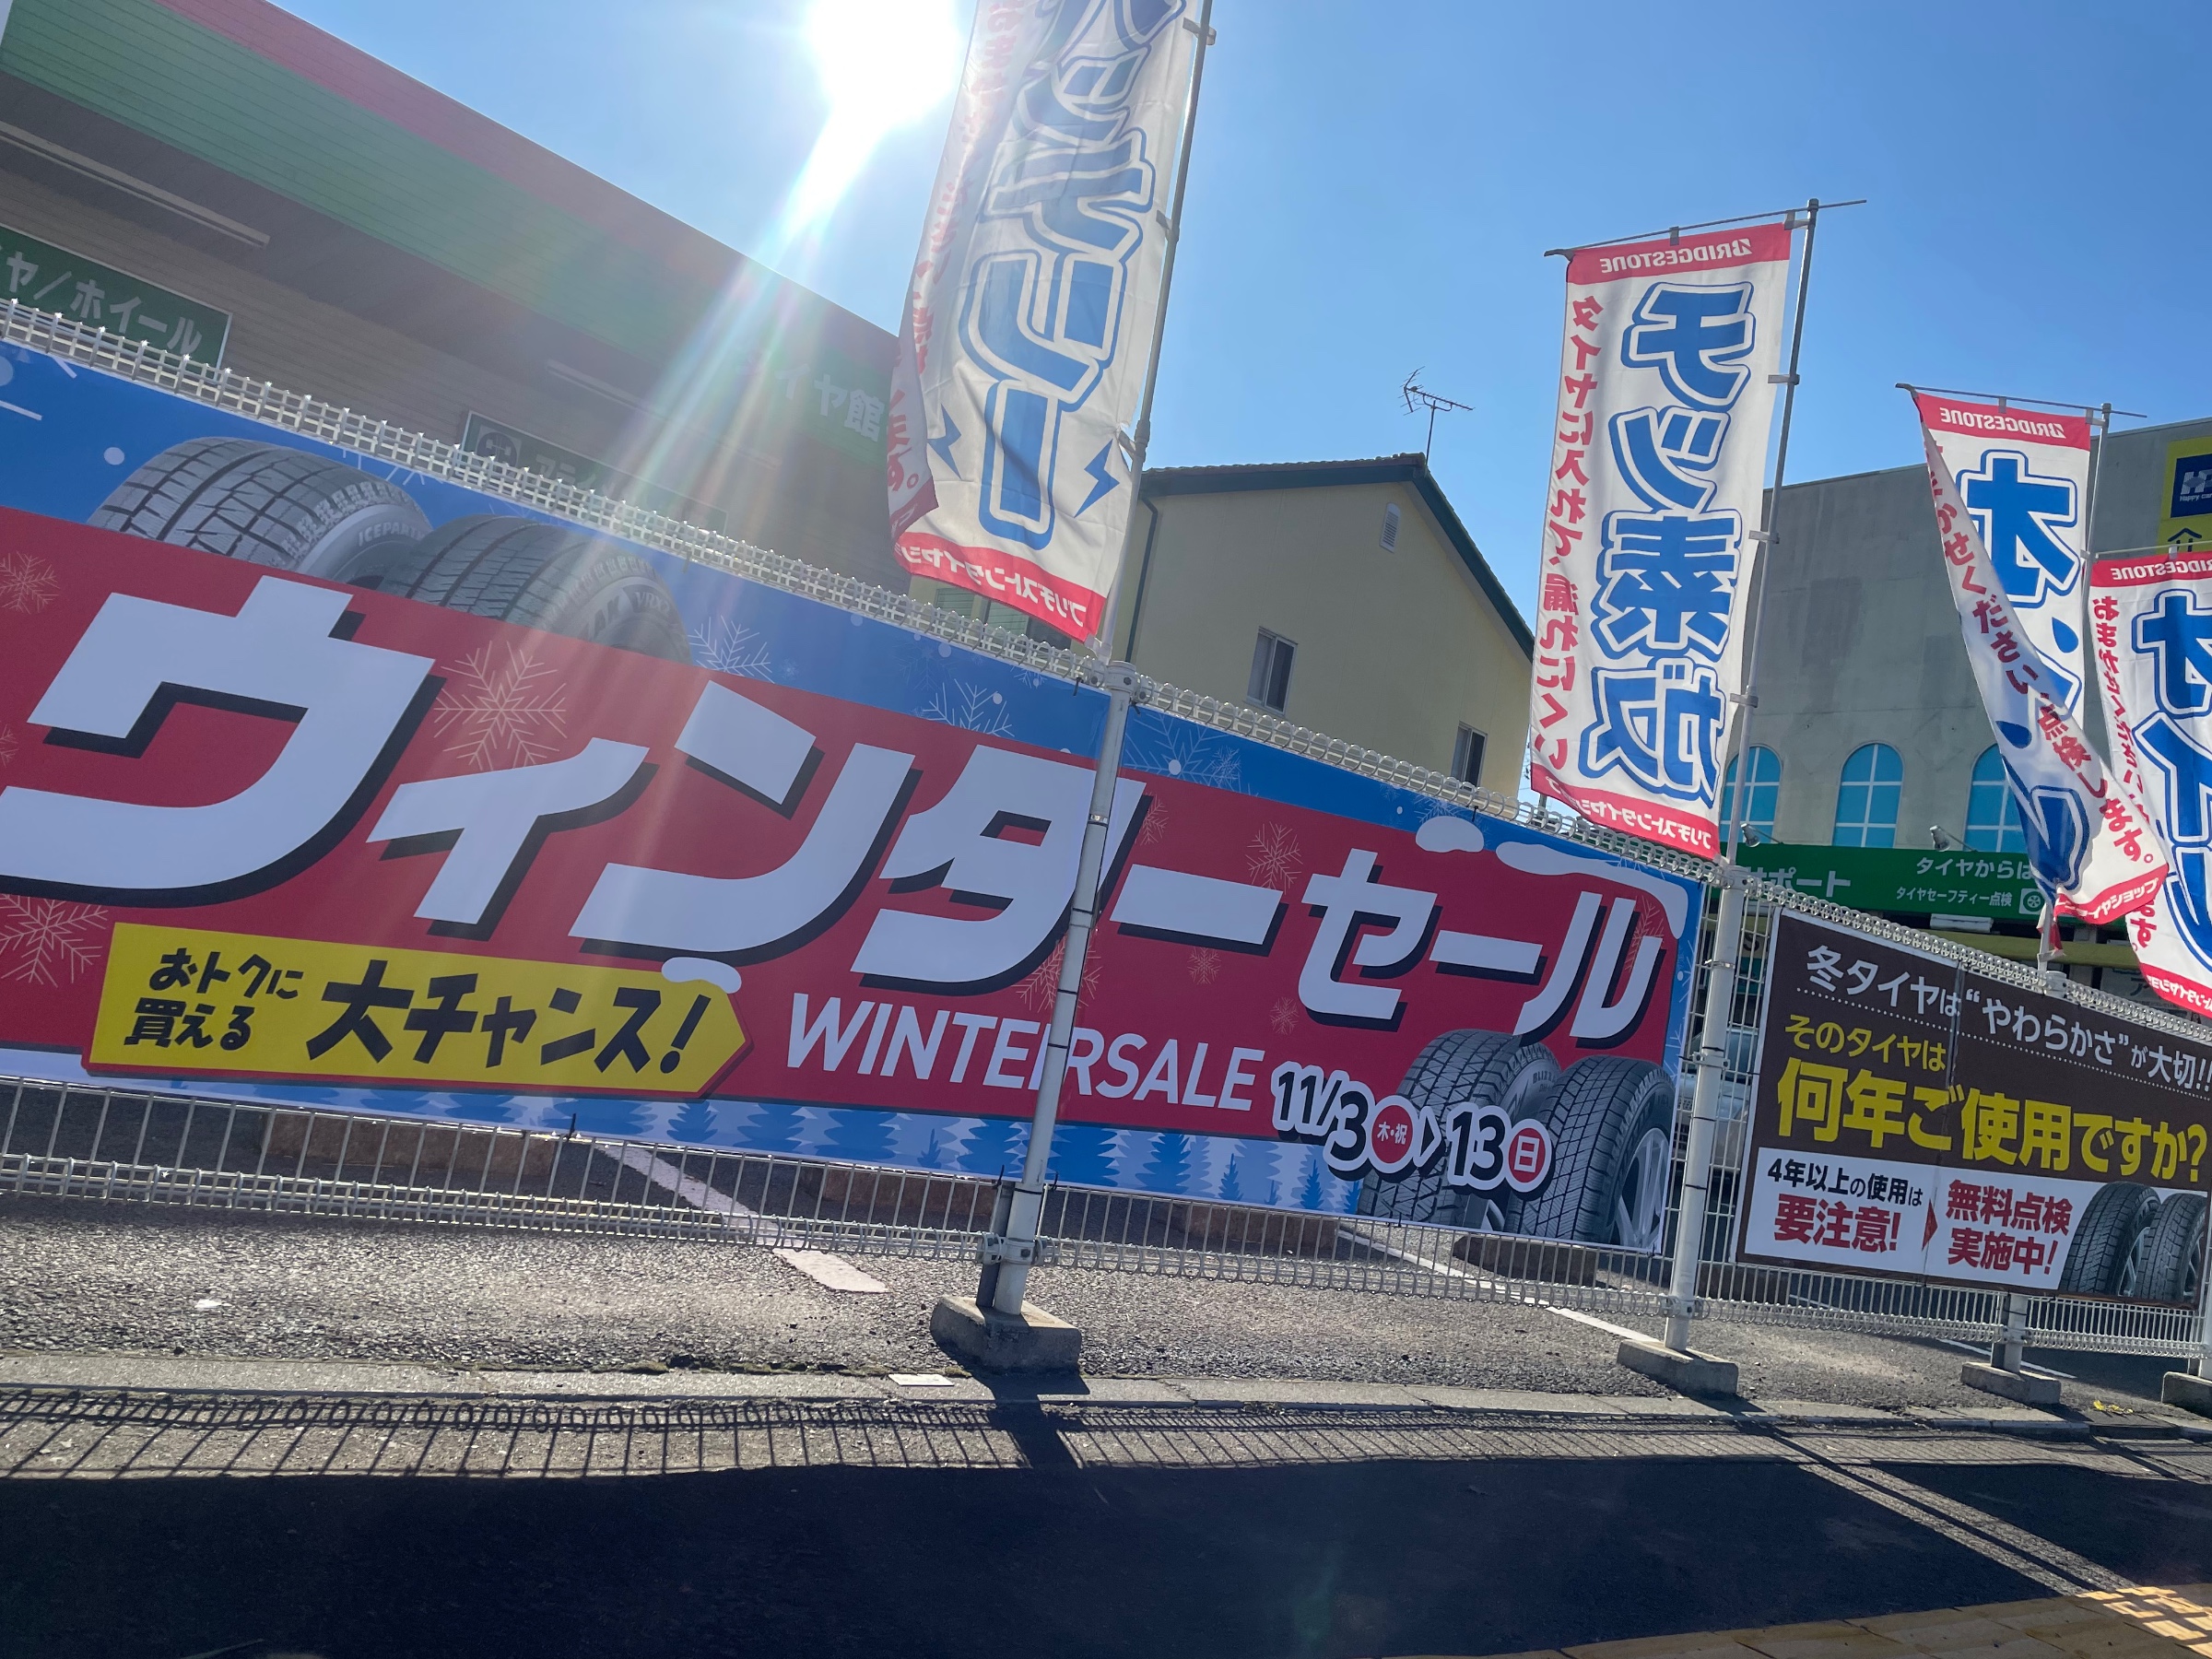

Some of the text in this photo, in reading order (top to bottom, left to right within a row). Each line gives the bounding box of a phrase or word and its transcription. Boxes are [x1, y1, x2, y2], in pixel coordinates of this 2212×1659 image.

[0, 575, 1665, 1048] ウィンターセール
[1896, 887, 2013, 908] タイヤセーフティー点検
[149, 947, 304, 999] おトクに
[124, 997, 253, 1053] 買える
[1784, 1014, 1947, 1072] そのタイヤは
[1276, 1069, 1371, 1164] 11/3
[1451, 1108, 1508, 1182] 13
[1513, 1136, 1542, 1173] 日
[1777, 1059, 2208, 1183] 何年ご使用ですか?
[1767, 1159, 1924, 1206] 4年以上の使用は
[1946, 1180, 2074, 1237] 無料点検
[1773, 1193, 1900, 1253] 要注意!
[1947, 1226, 2057, 1276] 実施中!
